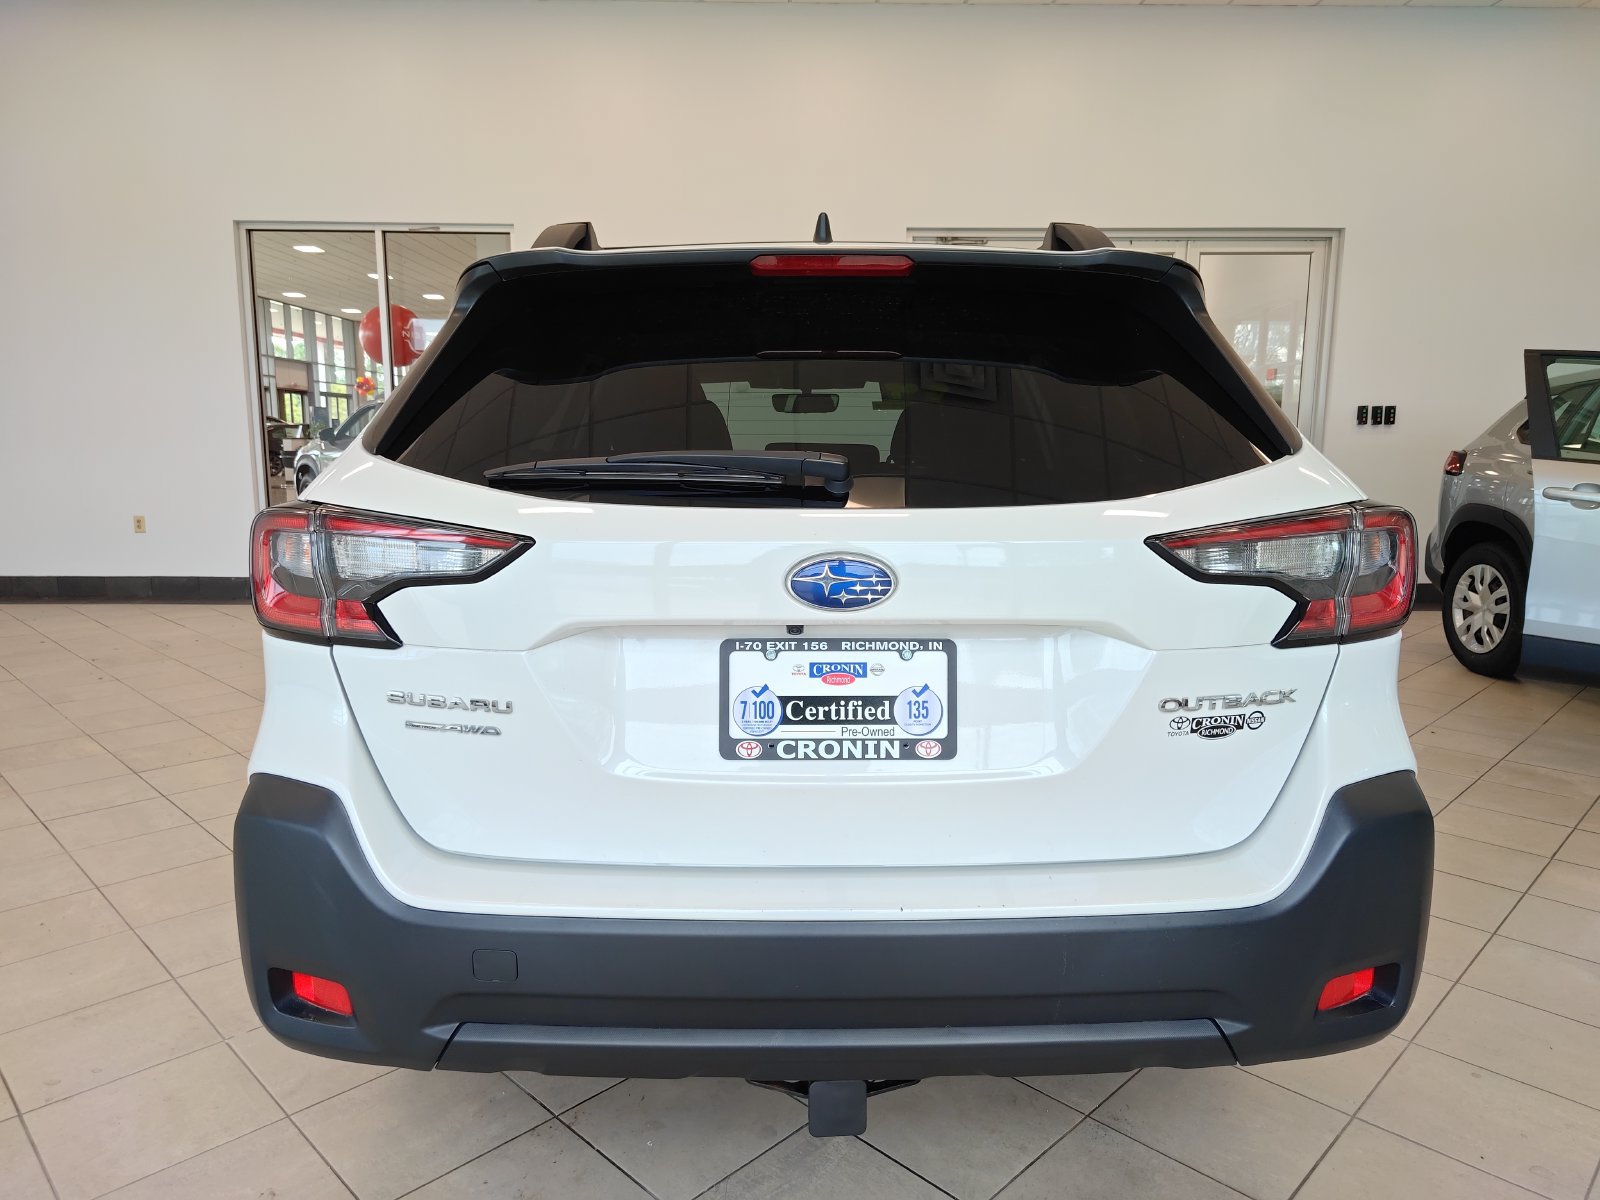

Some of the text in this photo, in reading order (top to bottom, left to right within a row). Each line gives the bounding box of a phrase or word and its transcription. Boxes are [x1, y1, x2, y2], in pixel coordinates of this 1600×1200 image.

[735, 641, 943, 650] I-70 EXIT 156 RICHMOND, IN
[813, 664, 864, 676] CRONIN
[386, 689, 513, 714] SUBARU
[1158, 688, 1298, 712] OUTBACK
[785, 700, 891, 721] Certified
[907, 700, 929, 719] 135
[1192, 714, 1245, 730] CRONIN
[841, 726, 895, 737] Pre-Owned
[1201, 727, 1234, 736] RICHMOND
[776, 740, 900, 759] CRONIN
